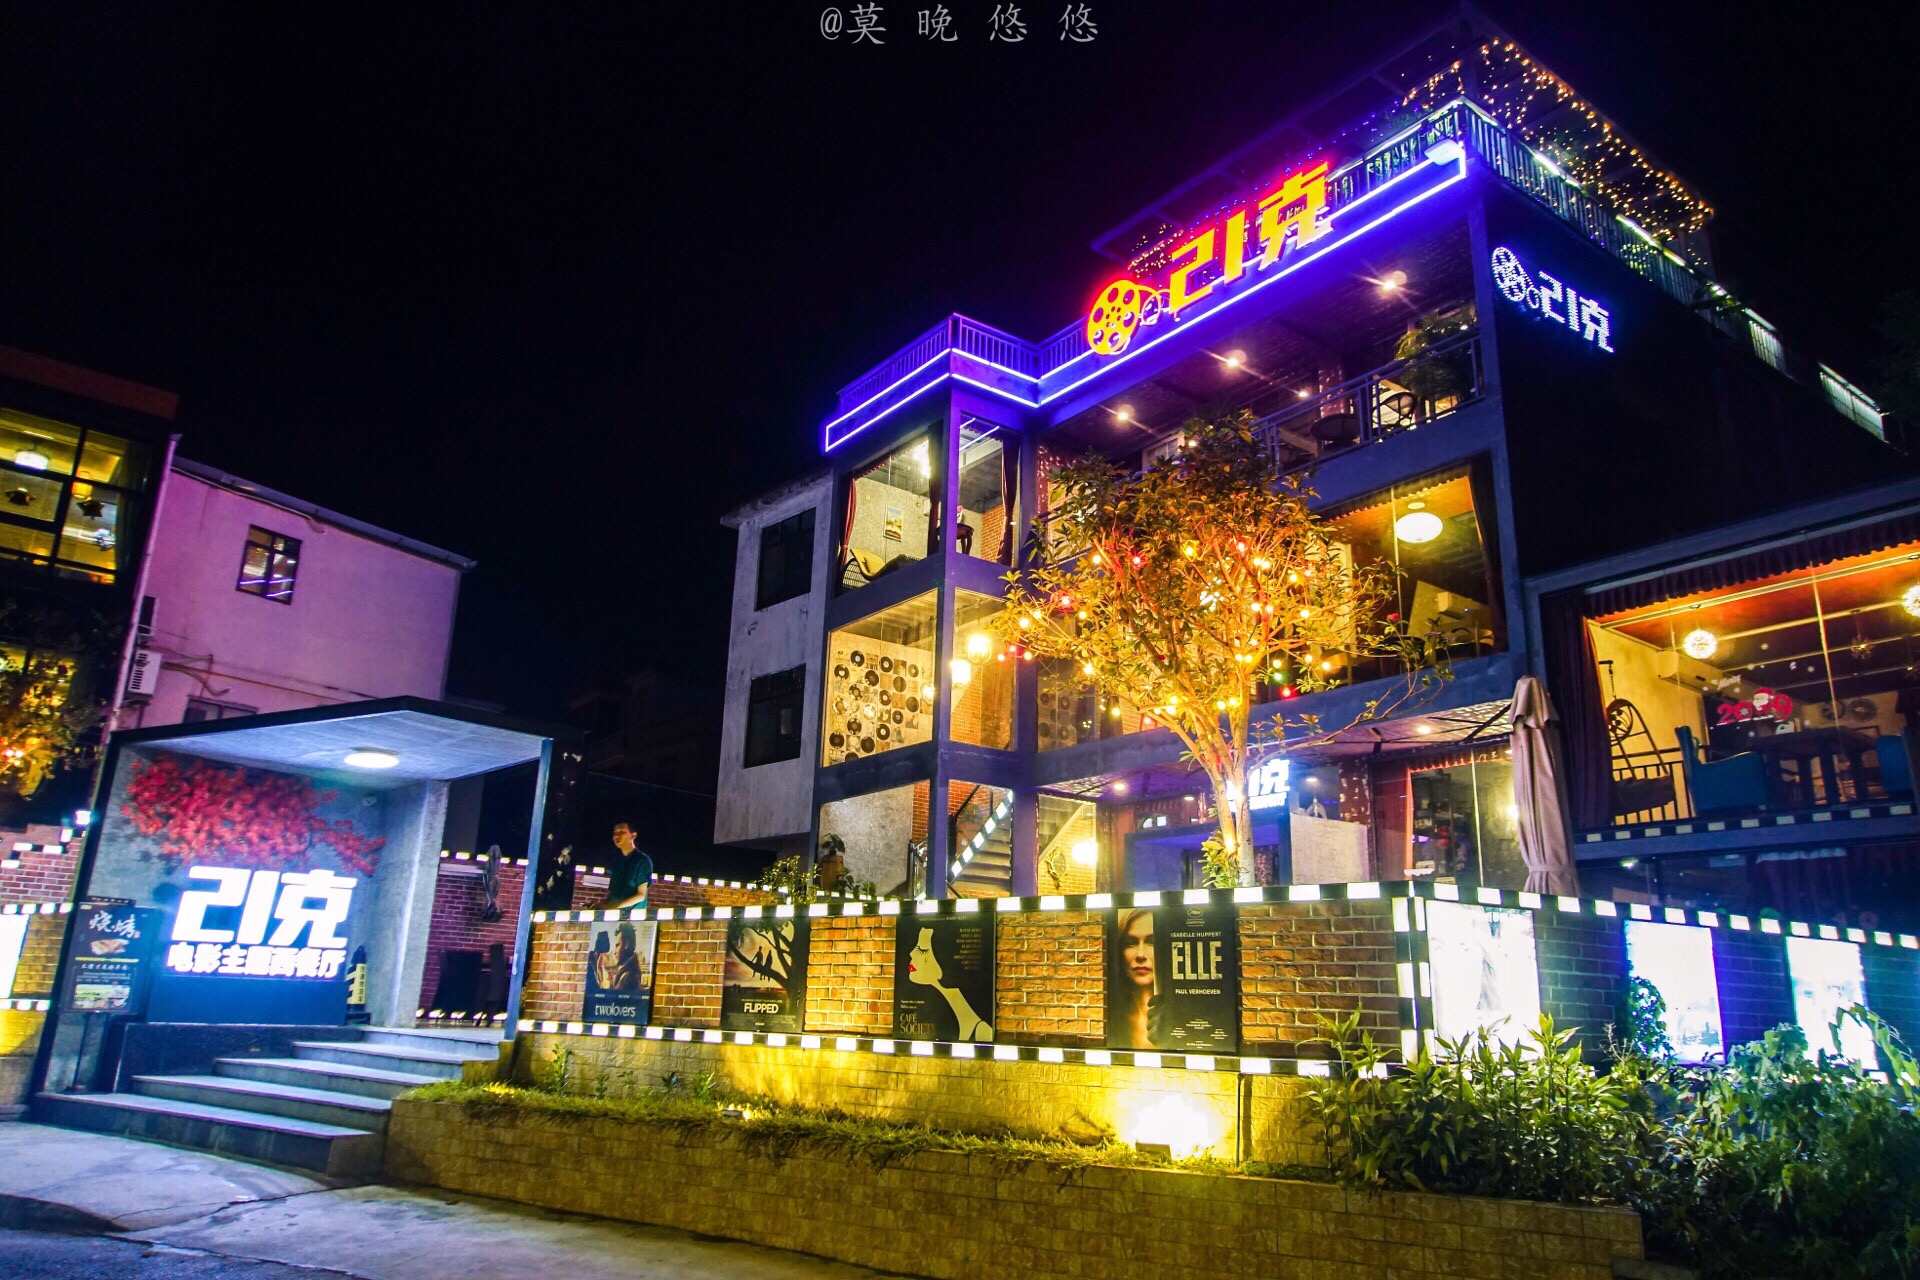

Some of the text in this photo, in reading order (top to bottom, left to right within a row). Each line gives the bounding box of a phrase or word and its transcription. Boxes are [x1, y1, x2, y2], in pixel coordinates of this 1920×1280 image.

[1169, 162, 1333, 314] 21克
[1538, 270, 1614, 353] 21克
[1717, 694, 1793, 724] 209
[171, 865, 358, 949] 21克
[1171, 941, 1223, 980] ELLE
[743, 1002, 779, 1014] FLIPPED
[900, 1023, 935, 1035] SOCIE
